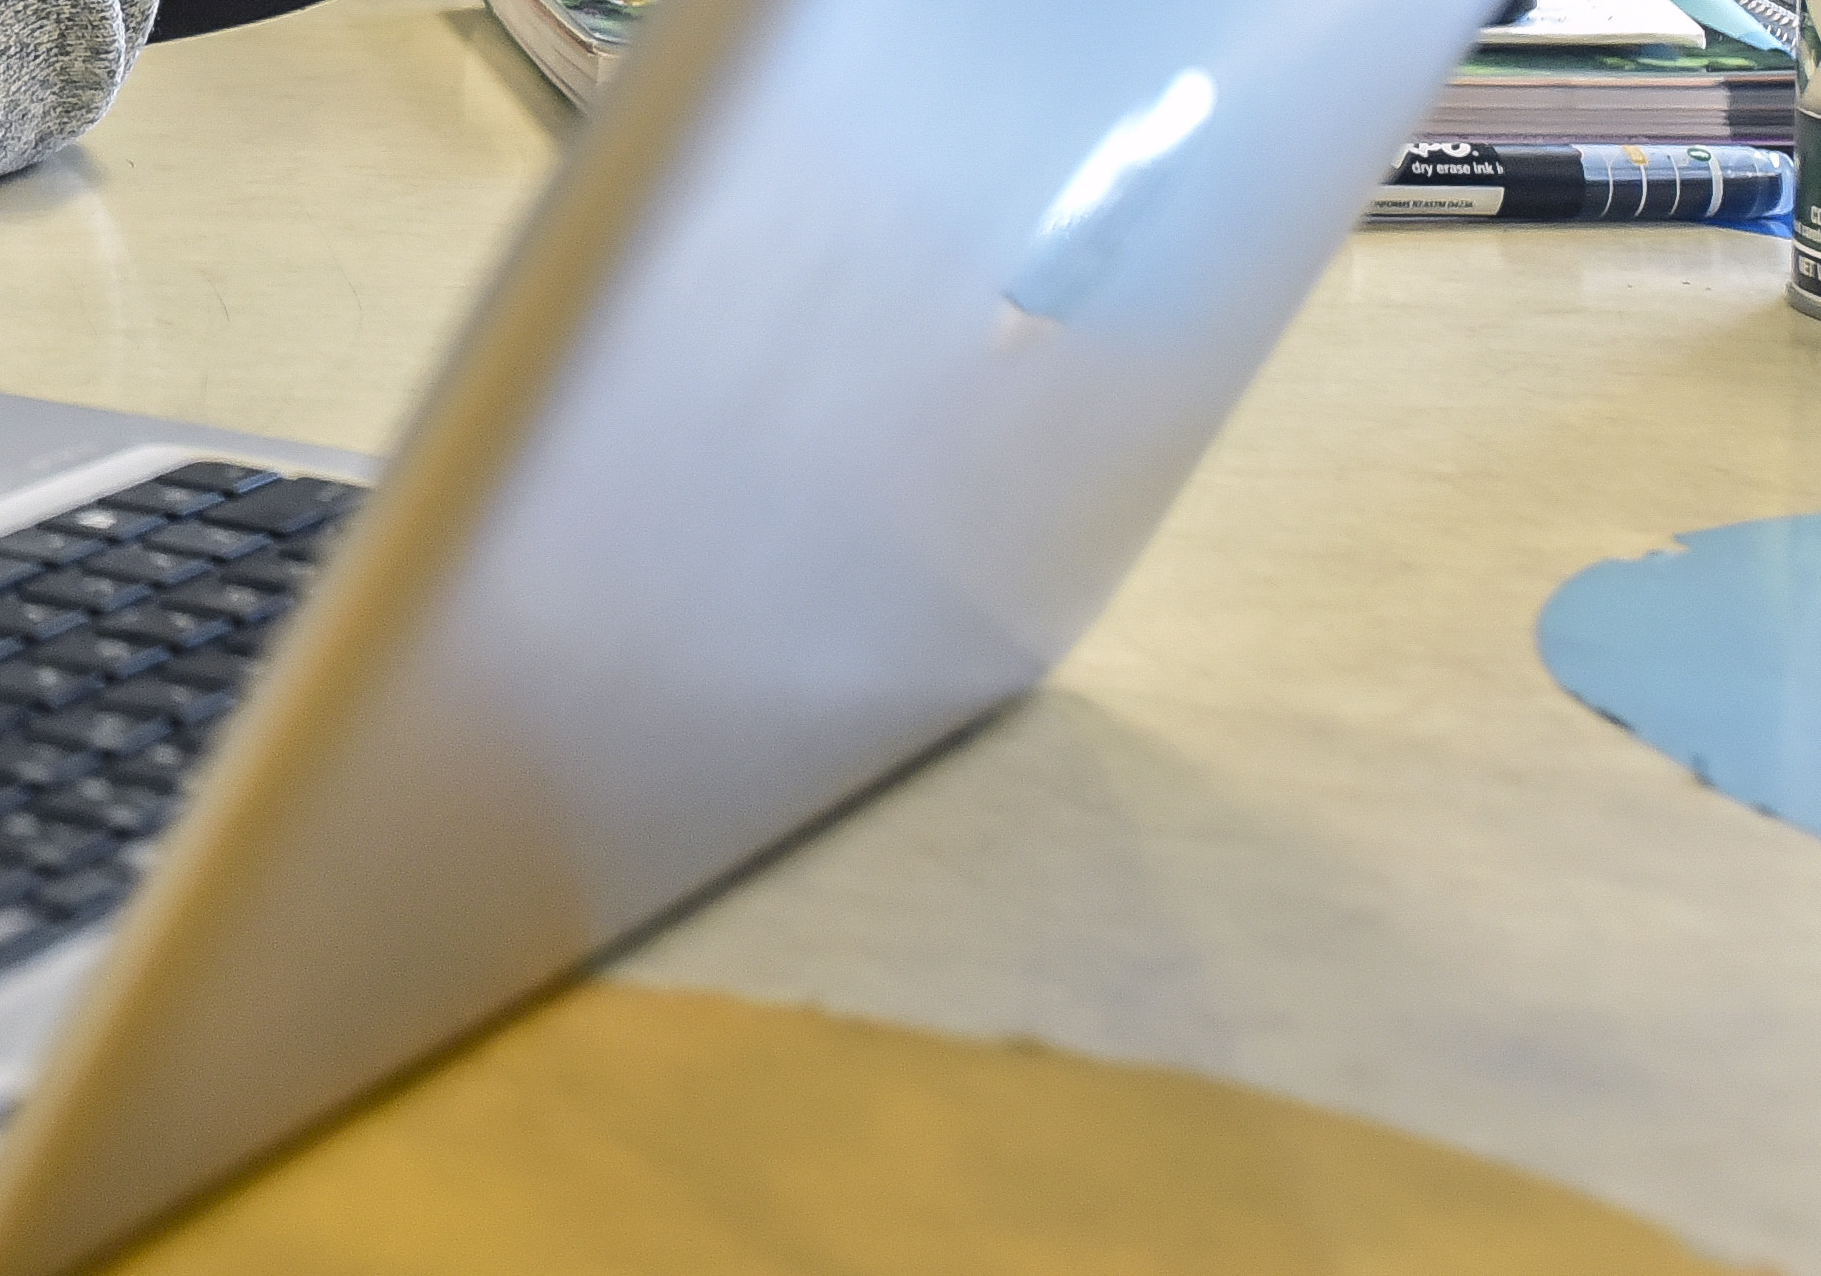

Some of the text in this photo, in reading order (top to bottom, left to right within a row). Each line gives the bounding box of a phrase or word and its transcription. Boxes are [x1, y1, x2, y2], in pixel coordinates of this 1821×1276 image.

[1411, 160, 1433, 177] dry
[1436, 163, 1471, 175] erase
[1473, 161, 1495, 175] ink
